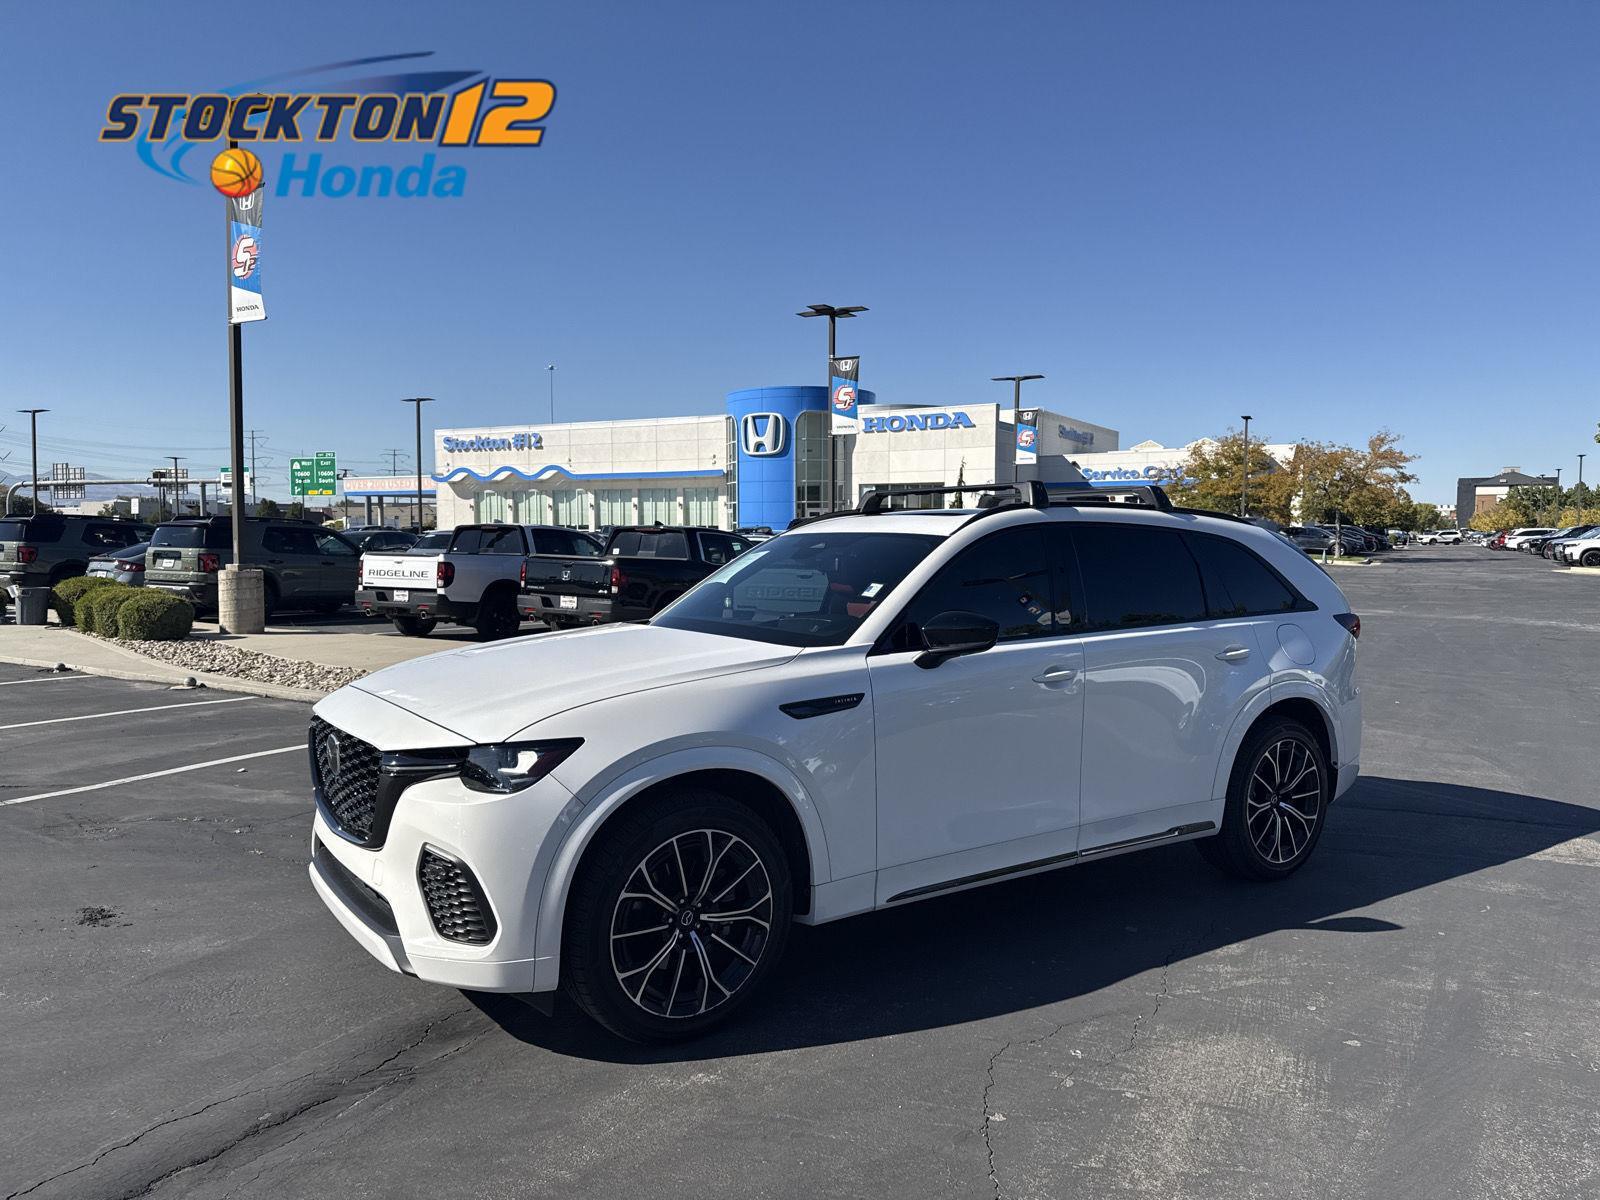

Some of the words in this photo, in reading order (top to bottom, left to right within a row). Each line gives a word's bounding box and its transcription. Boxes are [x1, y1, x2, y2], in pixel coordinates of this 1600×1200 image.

[236, 304, 260, 312] HONDA
[862, 411, 976, 433] HONDA
[443, 434, 510, 452] Stockton
[512, 432, 543, 449] #12
[1081, 466, 1140, 480] Service
[345, 480, 368, 490] OVER
[387, 479, 411, 489] USED
[368, 569, 429, 578] RIDGELINE
